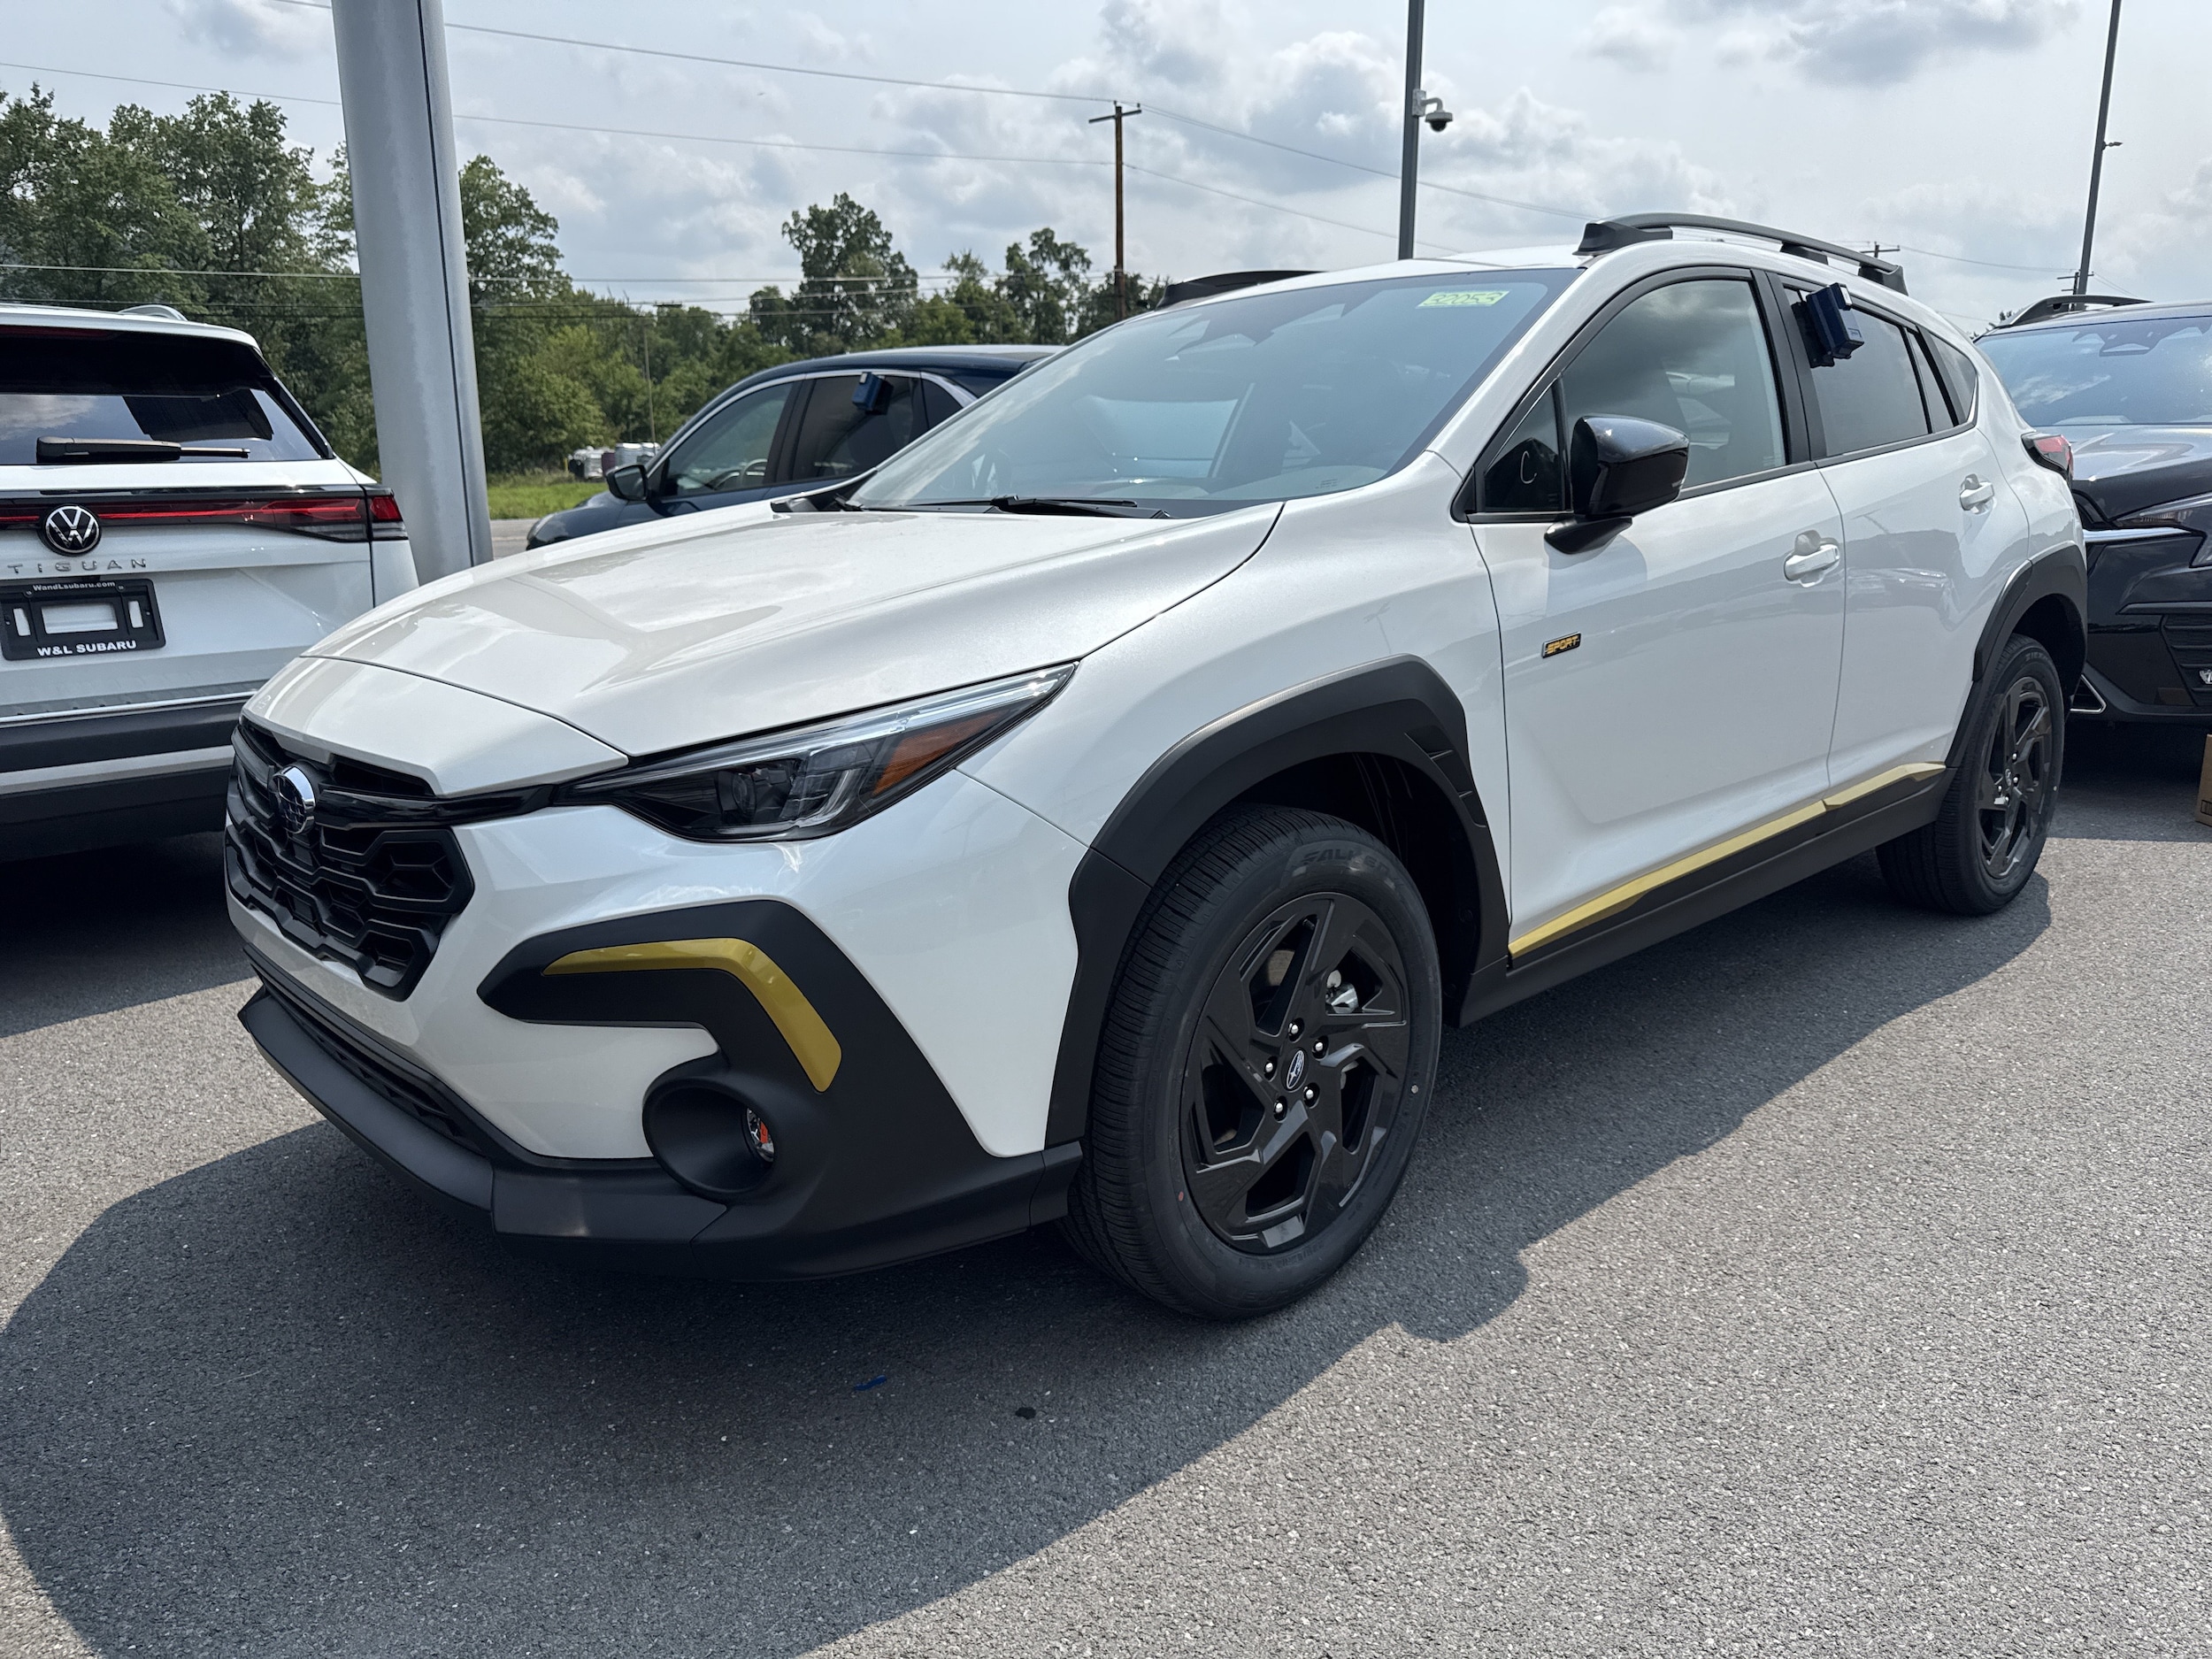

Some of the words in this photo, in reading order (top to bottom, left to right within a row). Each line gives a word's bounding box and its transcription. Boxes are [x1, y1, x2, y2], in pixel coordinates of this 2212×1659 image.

[8, 558, 147, 573] TIGUAN
[33, 581, 116, 591] WandLsubaru.com
[37, 647, 73, 656] W&L
[76, 640, 136, 653] SUBARU
[1547, 635, 1578, 655] SPORT
